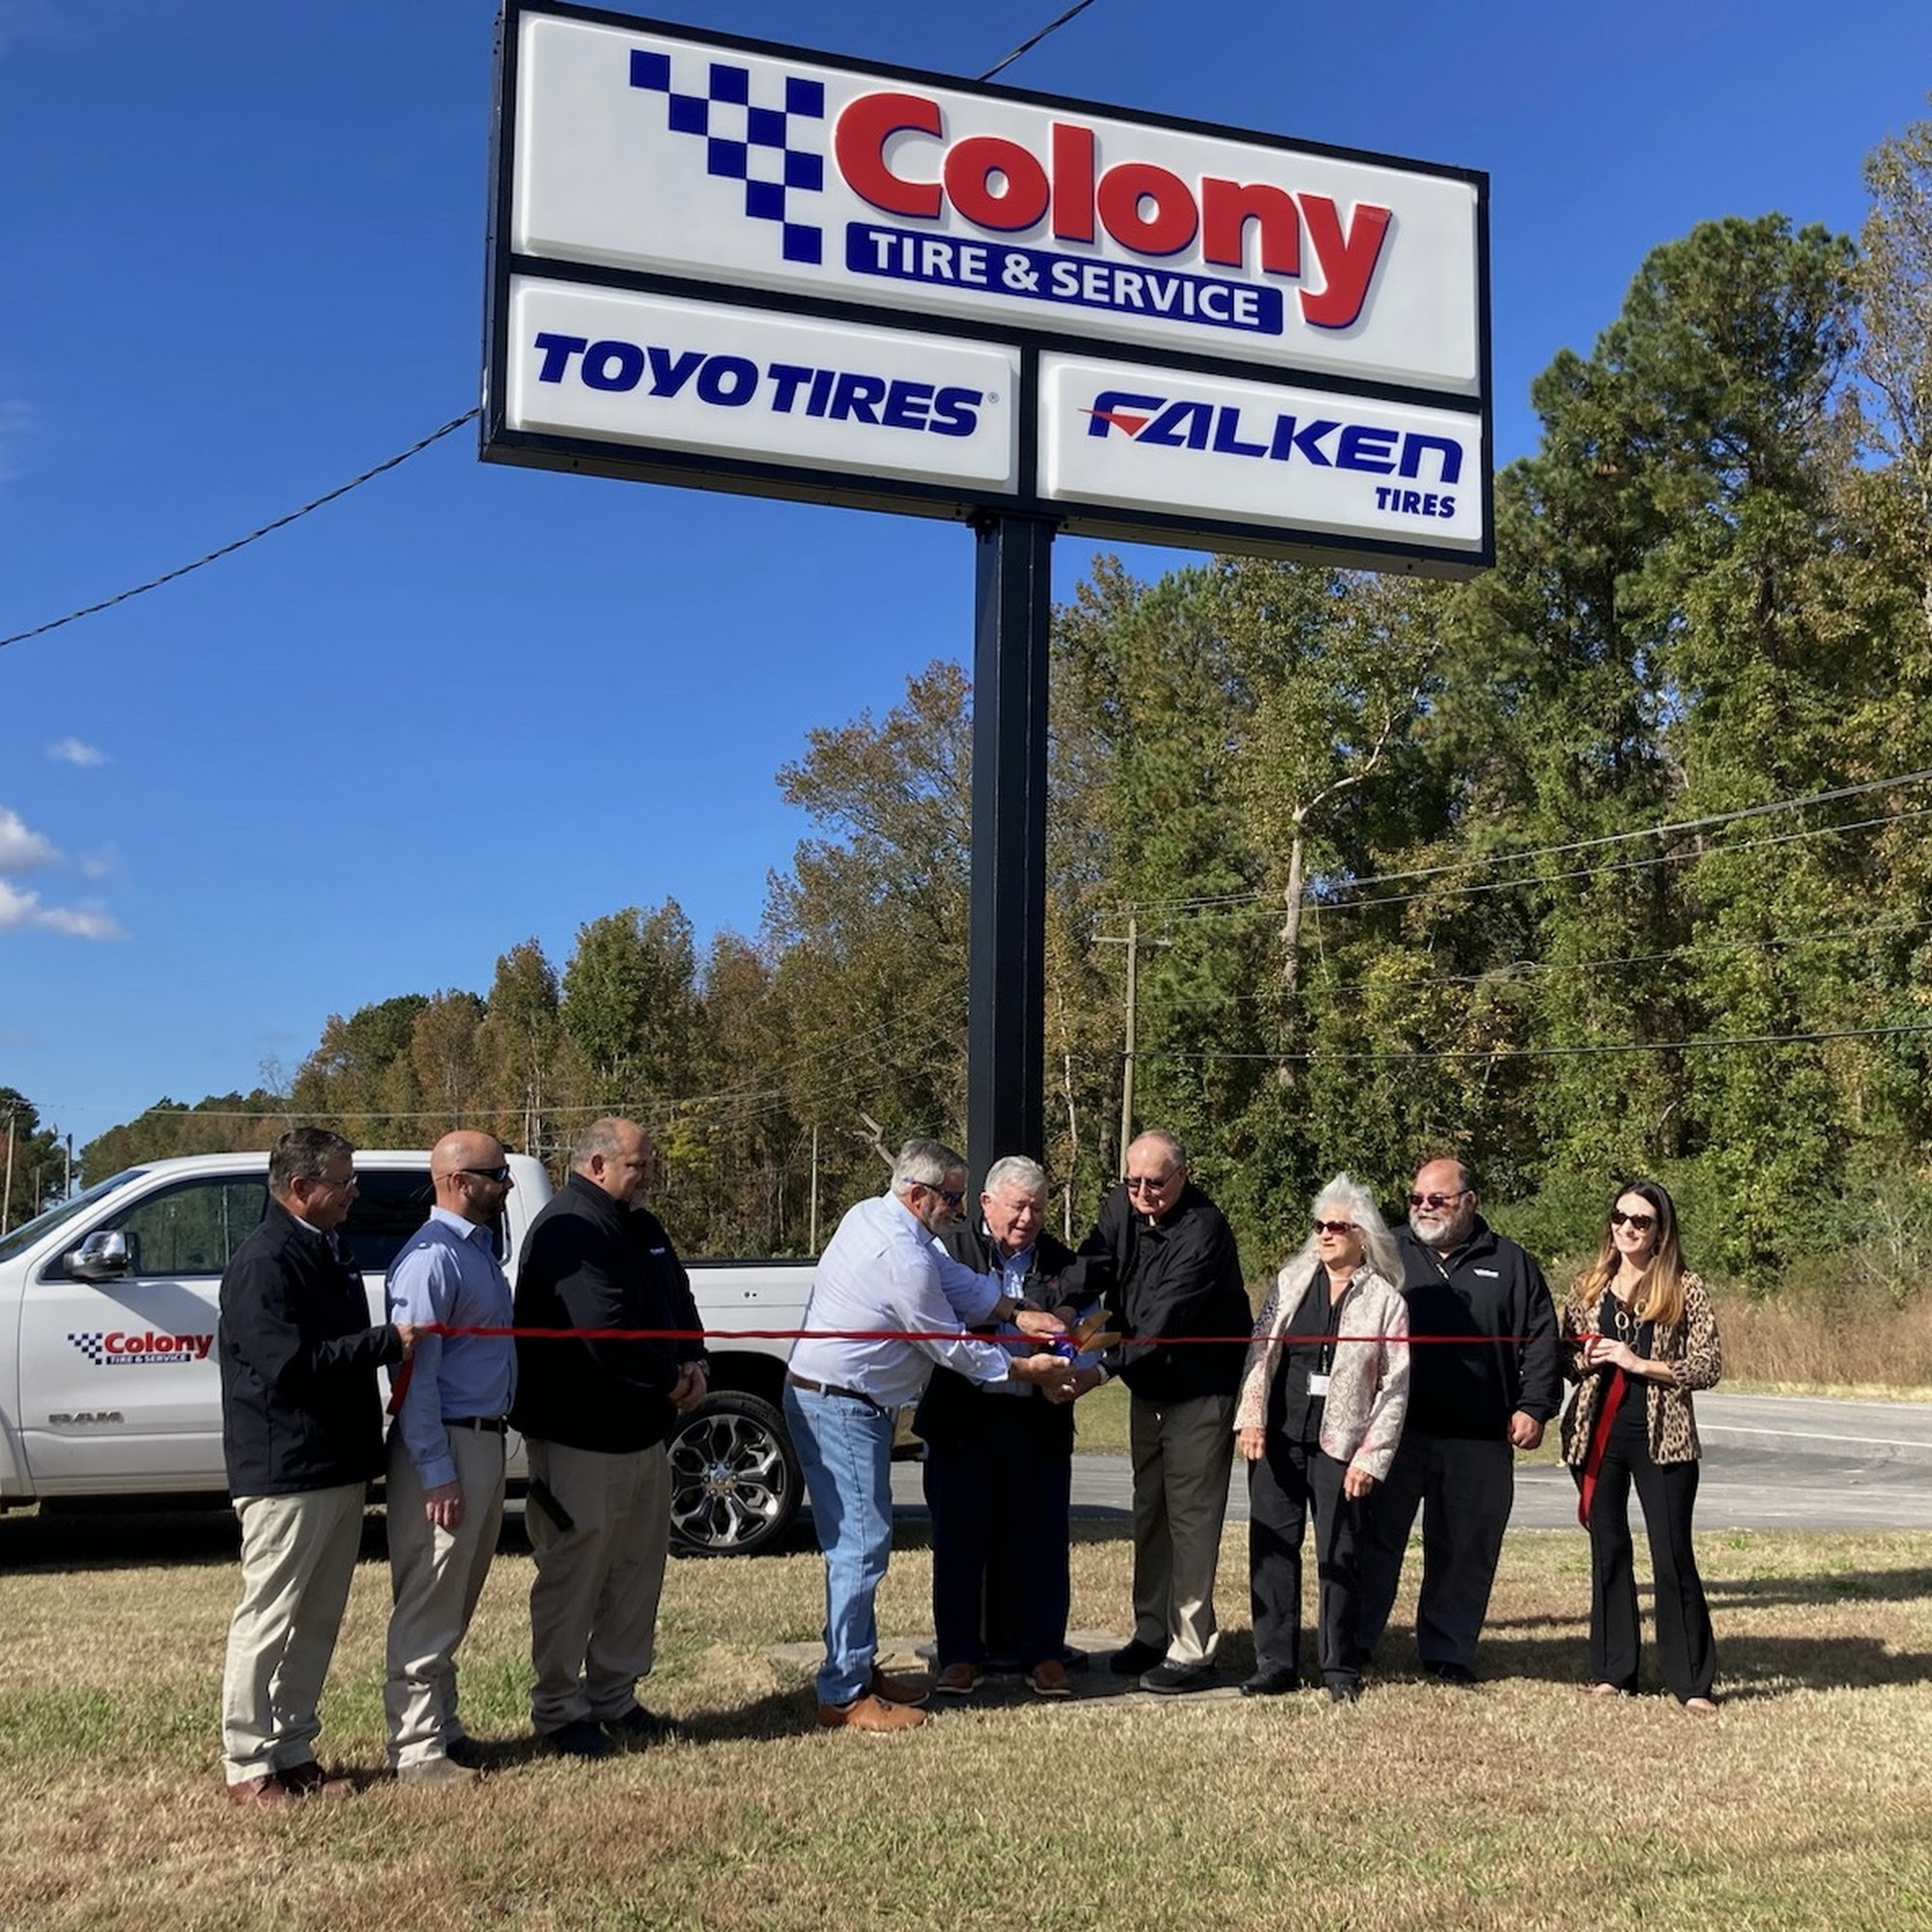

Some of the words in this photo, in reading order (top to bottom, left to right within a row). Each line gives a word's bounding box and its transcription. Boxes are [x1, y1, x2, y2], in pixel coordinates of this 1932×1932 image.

[834, 91, 1392, 329] Colony
[868, 231, 987, 284] TIRE
[1001, 252, 1039, 292] &
[1051, 261, 1260, 326] SERVICE
[534, 332, 758, 407] TOYO
[1078, 390, 1464, 484] FALKEN
[1376, 487, 1457, 519] TIRES
[104, 1331, 214, 1359] Colony
